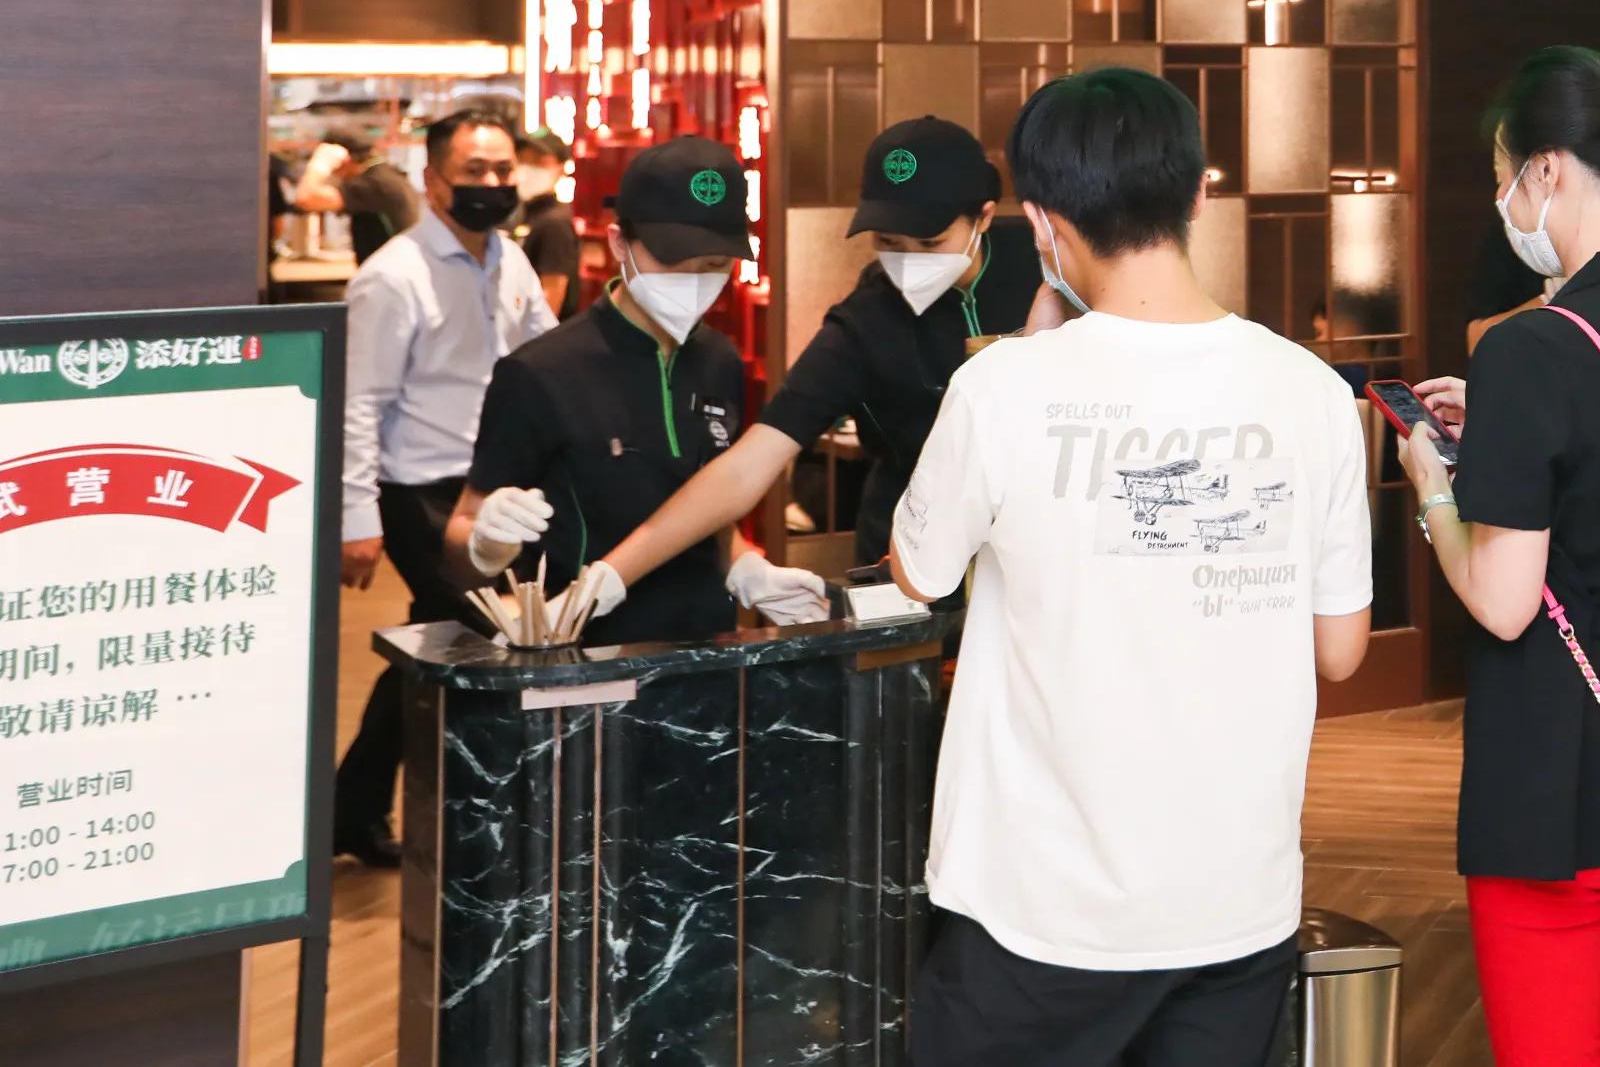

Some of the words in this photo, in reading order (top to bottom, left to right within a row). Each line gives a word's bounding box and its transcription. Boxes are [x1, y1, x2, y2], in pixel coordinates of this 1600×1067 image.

[134, 334, 244, 370] 添好運
[1045, 403, 1100, 420] SPELLS
[1104, 403, 1135, 420] OUT
[1131, 530, 1169, 542] FLYING
[1191, 564, 1298, 594] Операция
[17, 768, 133, 809] 营业时间
[85, 810, 156, 839] 14:00
[83, 841, 155, 871] 21:00
